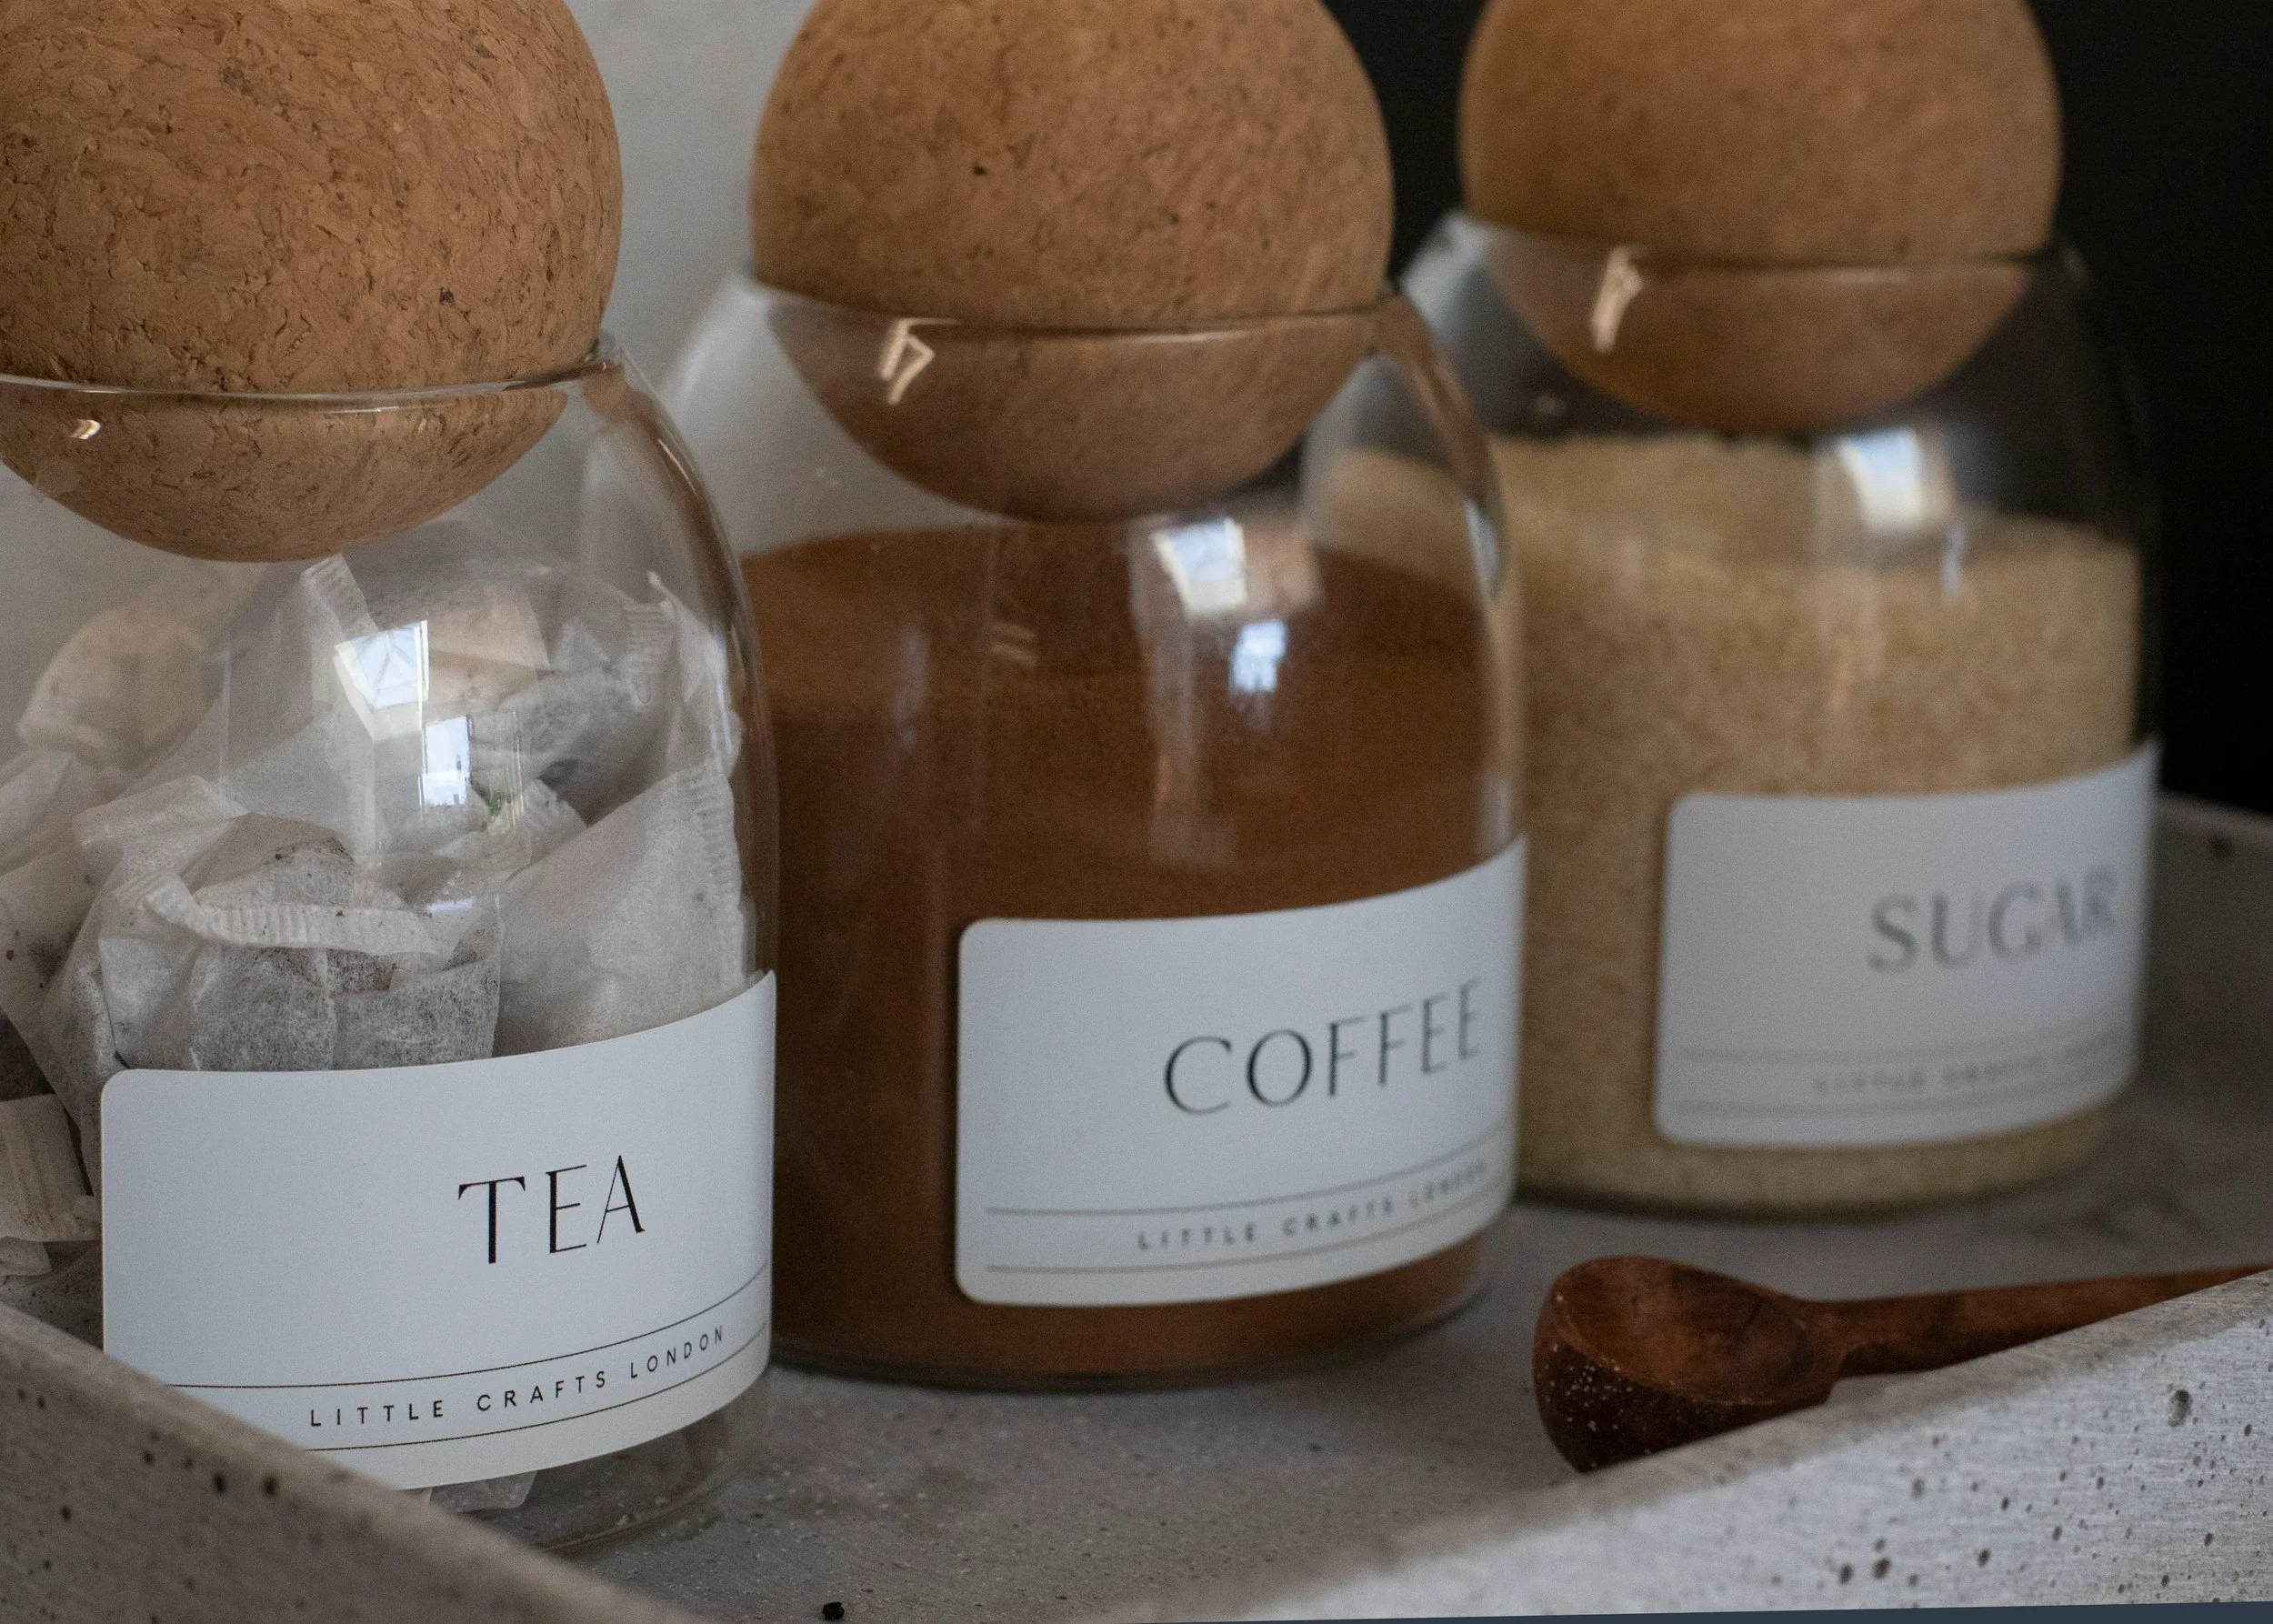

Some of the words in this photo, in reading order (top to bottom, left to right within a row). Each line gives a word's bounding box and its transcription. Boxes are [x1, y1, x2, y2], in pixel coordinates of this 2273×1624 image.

[1867, 864, 2120, 974] SUGAR
[1164, 977, 1485, 1116] COFFEE
[458, 1155, 646, 1264] TEA
[1137, 1223, 1257, 1251] LITTLE
[311, 1400, 444, 1427] LITTLE
[476, 1368, 606, 1412] CRAFTS
[630, 1324, 725, 1379] LONDON
